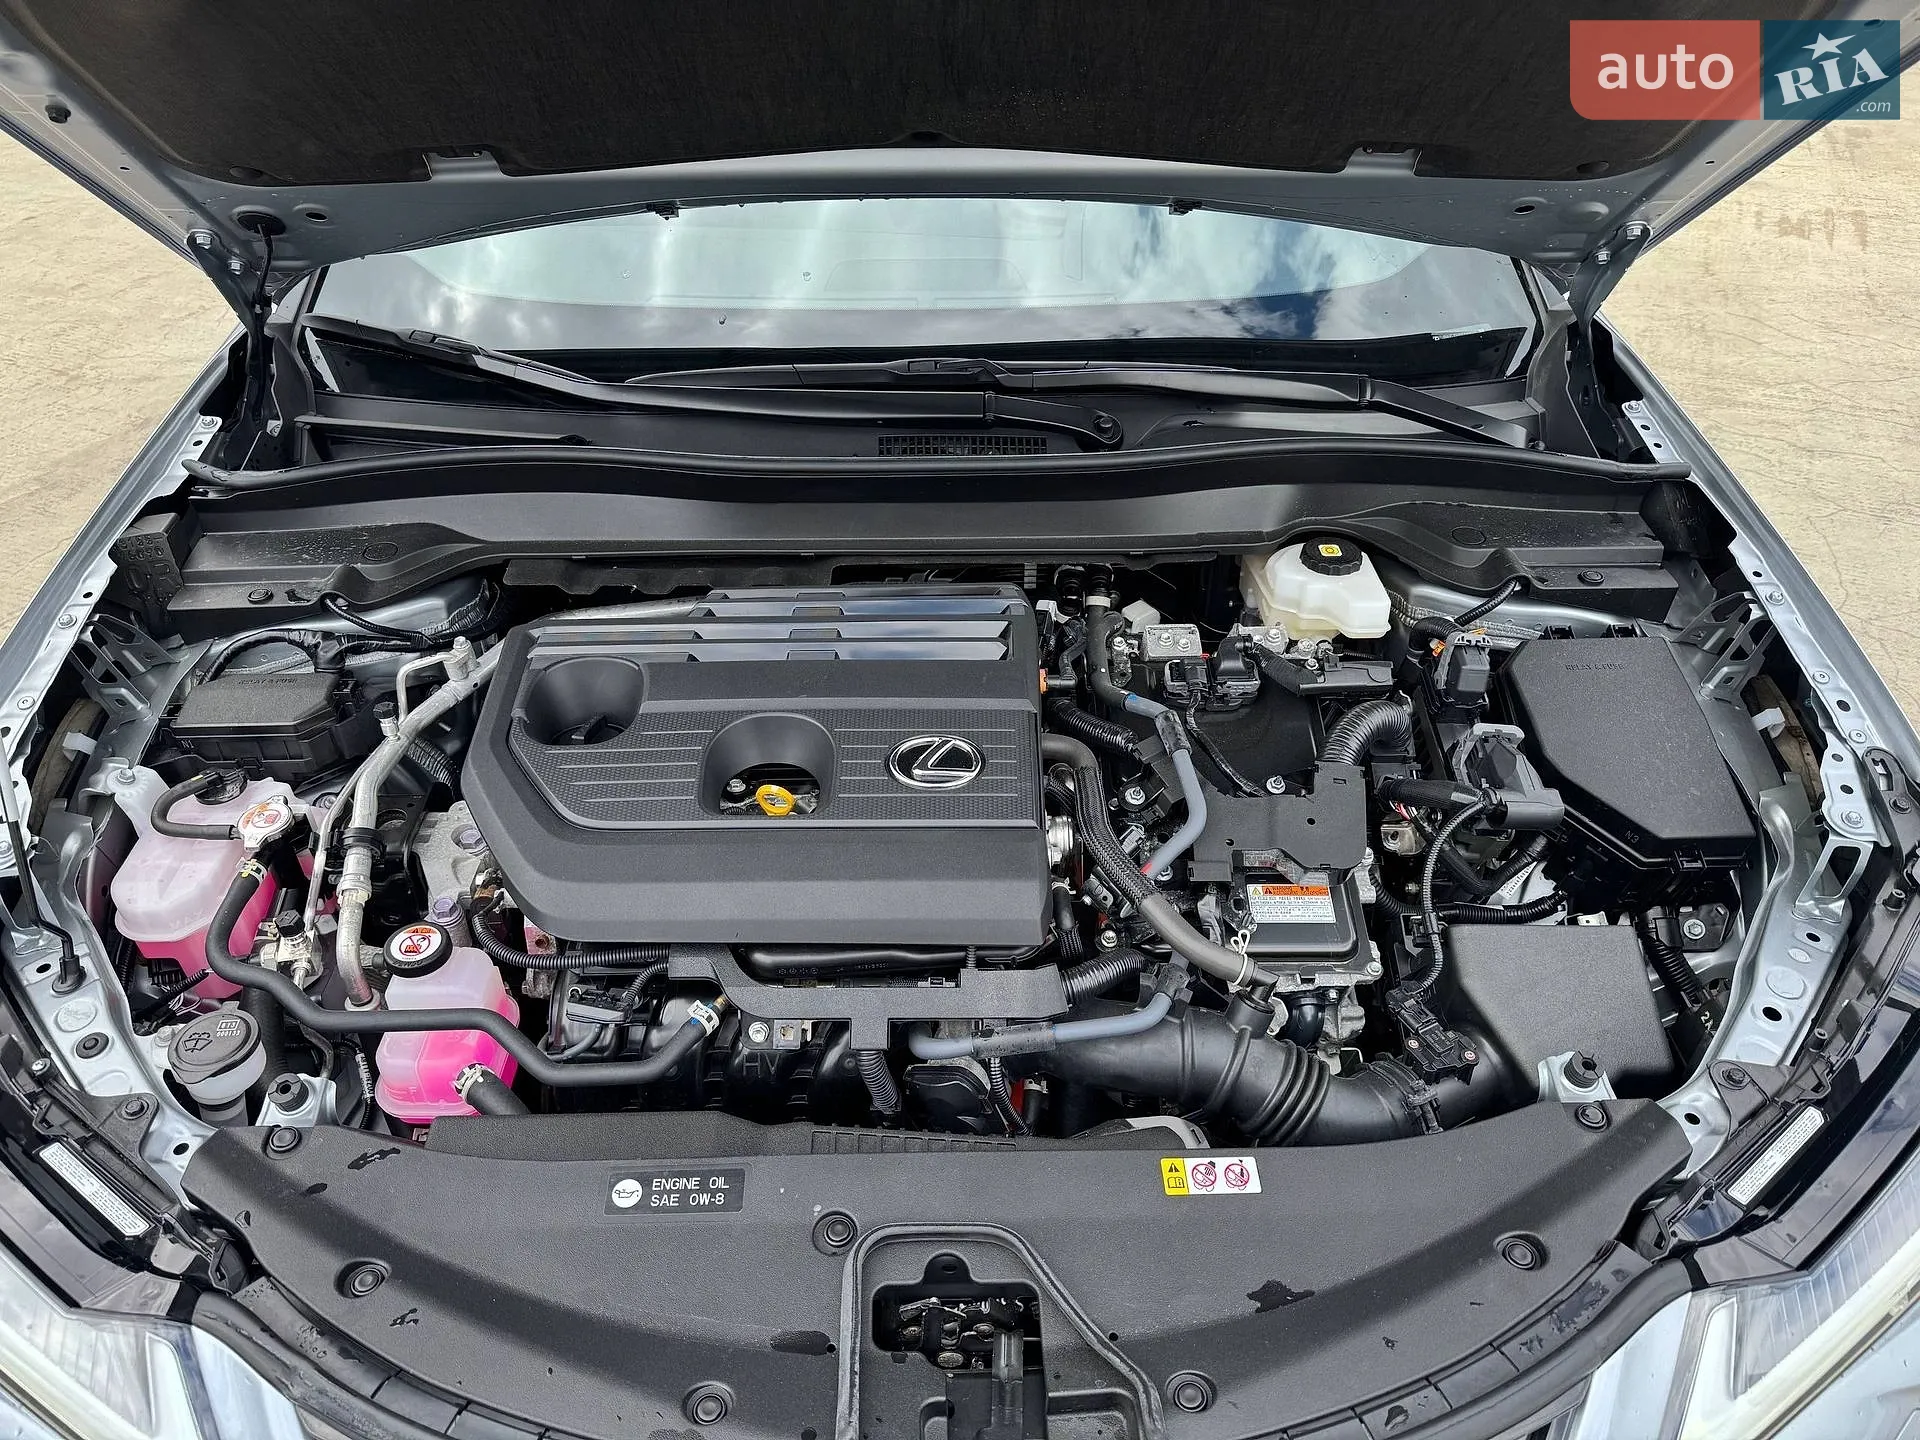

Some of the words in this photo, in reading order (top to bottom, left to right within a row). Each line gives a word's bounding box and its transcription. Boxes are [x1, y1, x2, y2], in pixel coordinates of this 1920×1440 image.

[1624, 830, 1640, 844] N3
[742, 1051, 781, 1077] HV
[651, 1177, 701, 1191] ENGINE
[709, 1176, 729, 1189] OIL
[650, 1194, 680, 1207] SAE
[689, 1192, 725, 1206] 0W-8
